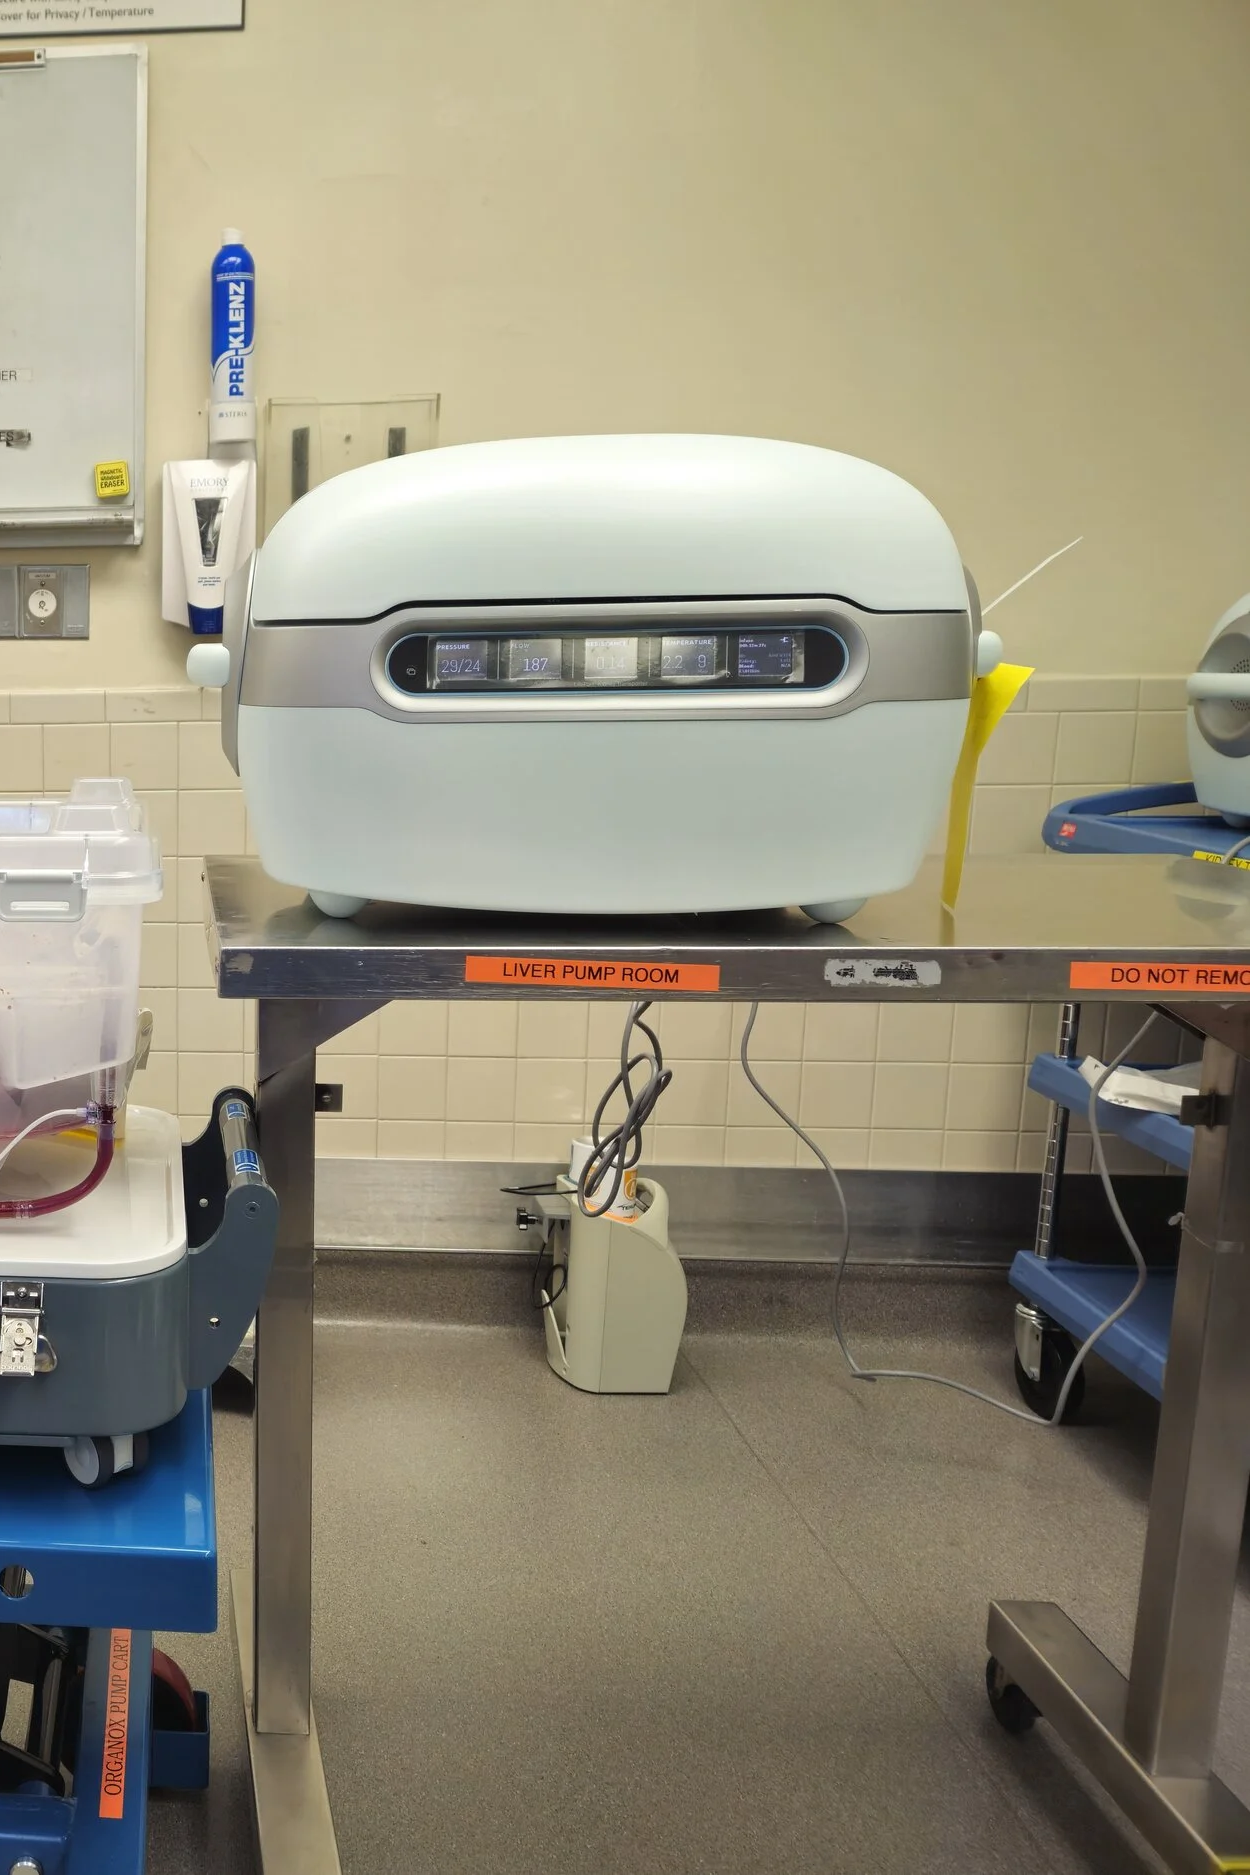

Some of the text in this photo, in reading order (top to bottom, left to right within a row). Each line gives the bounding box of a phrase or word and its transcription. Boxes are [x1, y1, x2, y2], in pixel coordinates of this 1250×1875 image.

[27, 9, 40, 21] for
[44, 7, 80, 22] Privacy
[90, 5, 154, 20] Temperature
[228, 281, 246, 397] PRE-KLENZ
[100, 479, 125, 488] ERASER
[190, 478, 230, 488] EMORY
[662, 638, 712, 646] TEMPERATURE
[441, 658, 481, 674] 29/24
[523, 657, 549, 672] 187
[663, 655, 684, 669] 2.2
[1205, 854, 1241, 868] KIDEY
[502, 962, 680, 984] LIVER PUMP ROOM
[1111, 967, 1141, 983] DO
[1147, 968, 1189, 984] NOT
[104, 1635, 129, 1796] ORGANOX PUMP CART
